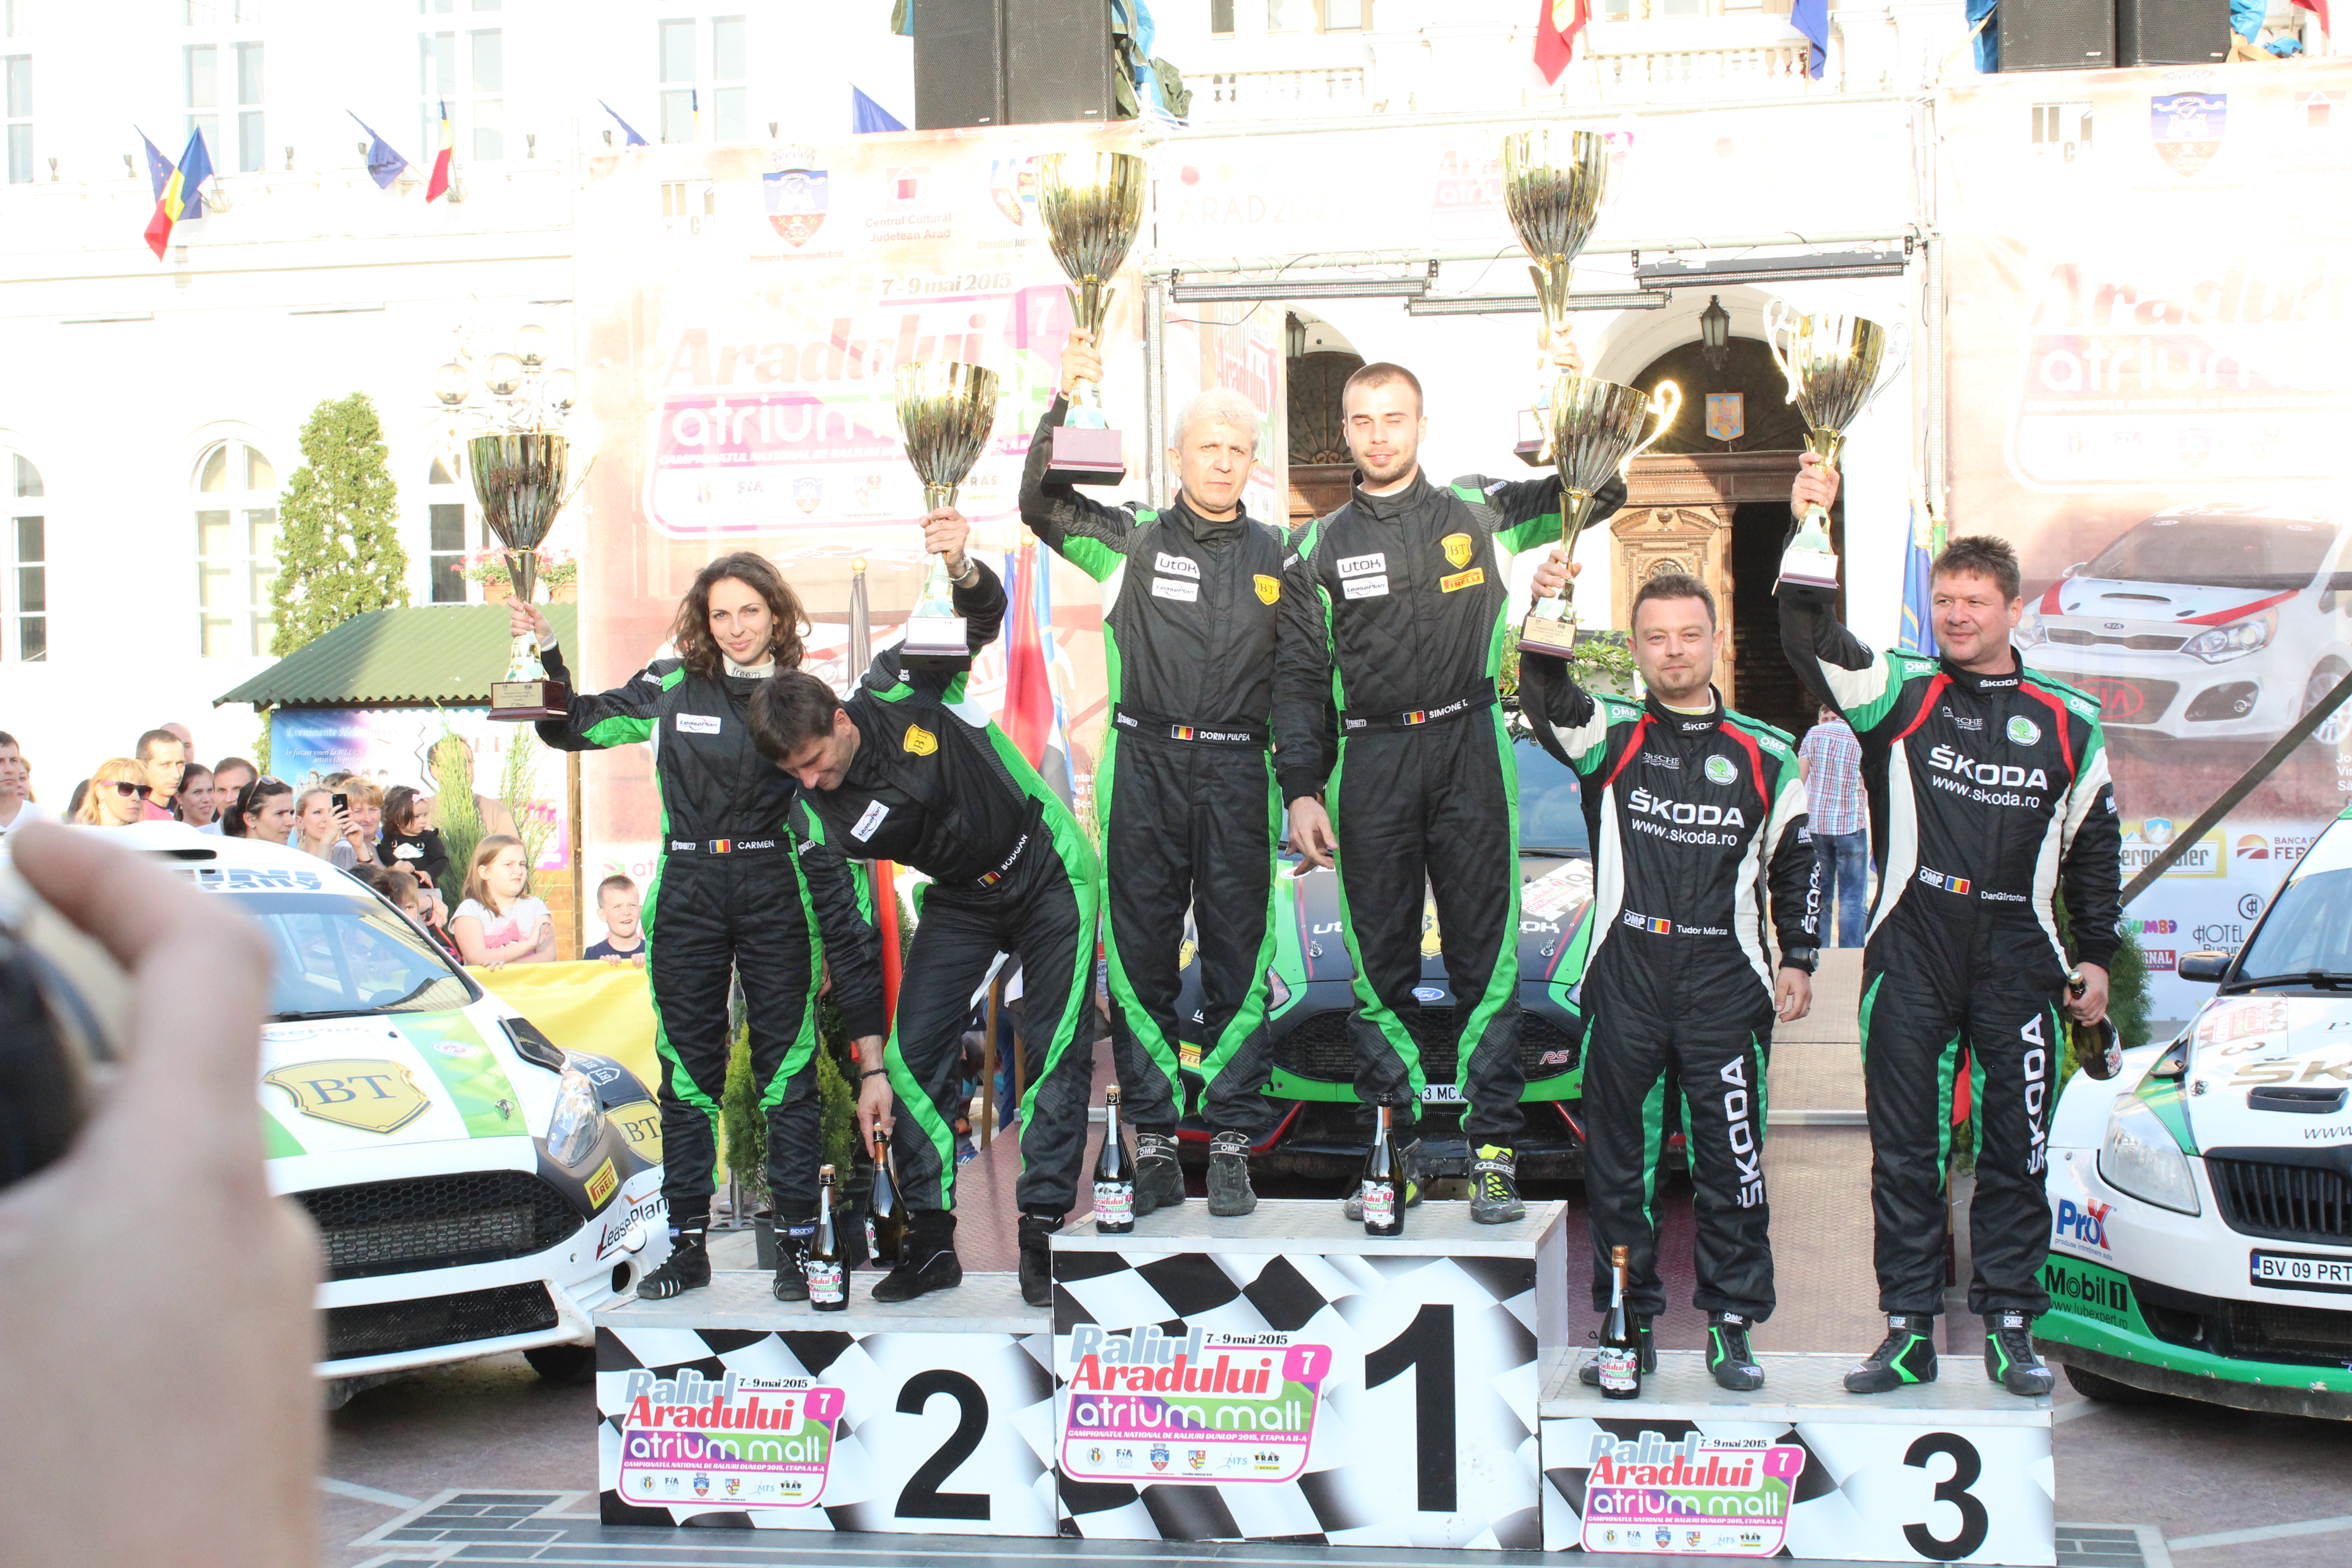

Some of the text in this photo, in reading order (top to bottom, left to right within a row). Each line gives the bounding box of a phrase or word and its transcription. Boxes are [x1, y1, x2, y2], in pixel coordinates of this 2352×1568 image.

[866, 212, 951, 228] Centrul Cultural
[870, 228, 951, 242] Judetean Arad
[882, 272, 1011, 295] 7 9 mai 2015
[1036, 297, 1055, 337] 7
[662, 313, 988, 387] Aradului
[672, 394, 882, 446] atrium
[659, 452, 749, 465] CAMPIONATUL
[750, 449, 810, 462] NATIONAL
[1449, 544, 1466, 556] BT
[1156, 584, 1194, 594] LeasePlan
[1259, 583, 1275, 594] BT
[1347, 583, 1385, 593] LeasePlan
[1443, 571, 1480, 590] PIRELLI
[1906, 662, 1932, 672] OMP
[1980, 678, 2019, 688] ŠKODA
[1429, 703, 1460, 719] SIMONE
[1612, 708, 1637, 718] OMP
[2070, 698, 2094, 714] OMP
[287, 728, 337, 737] Evenimente
[680, 720, 717, 730] LeasePlan
[1346, 718, 1367, 730] freem
[1683, 721, 1714, 731] ŠKOD
[913, 731, 928, 749] BT
[1200, 731, 1250, 741] DORIN PULPEA
[1760, 736, 1787, 751] OMP
[1928, 744, 2048, 791] ŠKODA
[1932, 774, 2040, 809] www.skoda.ro
[1627, 786, 1745, 828] ŠKODA
[1632, 818, 1738, 847] www.skoda.ro
[2274, 837, 2307, 845] BANCA
[671, 840, 696, 851] freem
[738, 840, 774, 850] CARMEN
[200, 878, 322, 890] rally
[1919, 868, 1944, 886] OMP
[1623, 912, 1646, 926] OMP
[1677, 925, 1728, 935] Tudor Mârza
[2193, 924, 2245, 944] HOTEL
[1415, 990, 1436, 999] Ford
[1539, 1049, 1569, 1065] RS
[299, 1074, 397, 1105] BT
[1437, 1088, 1461, 1100] MC
[2021, 1012, 2046, 1175] ŠKODA
[621, 1116, 662, 1142] BT
[1721, 1054, 1764, 1209] ŠKODA
[1139, 1147, 1156, 1156] OMP
[590, 1164, 616, 1202] PIRELLI
[596, 1197, 669, 1262] LeasePlan
[2055, 1238, 2113, 1261] produse auto
[2263, 1260, 2352, 1281] BV 09 PRT
[2045, 1264, 2106, 1306] Mobil
[1724, 1313, 1743, 1323] OMP
[1070, 1326, 1203, 1365] Raliul
[1206, 1333, 1288, 1345] 7 9 mai 2015
[1302, 1351, 1315, 1375] 7
[740, 1378, 808, 1388] 7 9 mai 2015
[1070, 1354, 1272, 1394] Aradului
[625, 1372, 736, 1405] Raliul
[625, 1395, 795, 1430] Aradului
[819, 1393, 831, 1414] 7
[1365, 1303, 1457, 1513] 1
[1076, 1396, 1301, 1431] atrium mall
[894, 1369, 991, 1521] 2
[1068, 1430, 1123, 1439] CAMPIONATUL
[1123, 1431, 1161, 1440] NATIONAL
[1161, 1431, 1173, 1440] DE
[1174, 1432, 1205, 1441] RALIURI
[1205, 1433, 1238, 1441] DUNLOP
[1238, 1433, 1259, 1442] 2015,
[1260, 1434, 1285, 1442] ETAPA
[1292, 1435, 1307, 1443] II-A
[1700, 1439, 1767, 1448] 7 9 mai 2015
[630, 1432, 819, 1462] atrium mall
[1588, 1434, 1698, 1465] Raliul
[1227, 1456, 1248, 1465] MTS
[1779, 1452, 1789, 1471] 7
[1588, 1455, 1754, 1487] Aradului
[757, 1484, 775, 1493] MTS
[1902, 1431, 1989, 1561] 3
[1594, 1489, 1779, 1516] atrium mall
